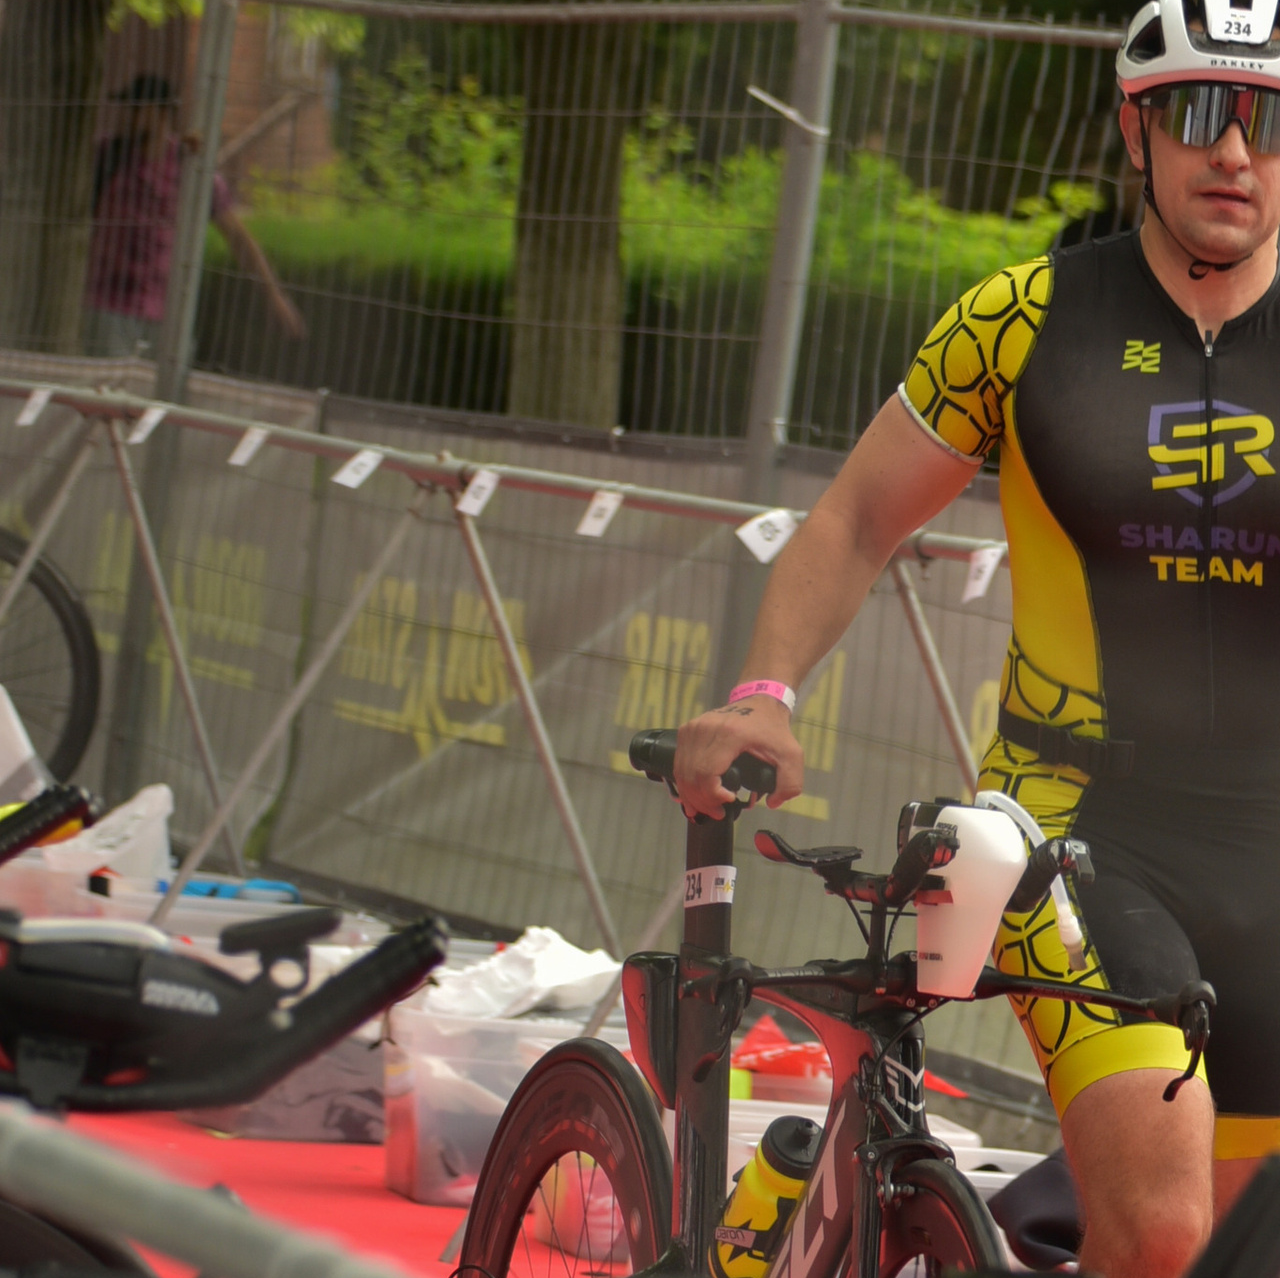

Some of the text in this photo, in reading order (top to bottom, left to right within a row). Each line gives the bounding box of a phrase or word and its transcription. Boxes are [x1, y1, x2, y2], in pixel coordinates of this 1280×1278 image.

[1223, 20, 1252, 37] 234
[1210, 59, 1265, 71] OAKLEY
[1149, 555, 1264, 587] TEAM
[685, 871, 702, 902] 234
